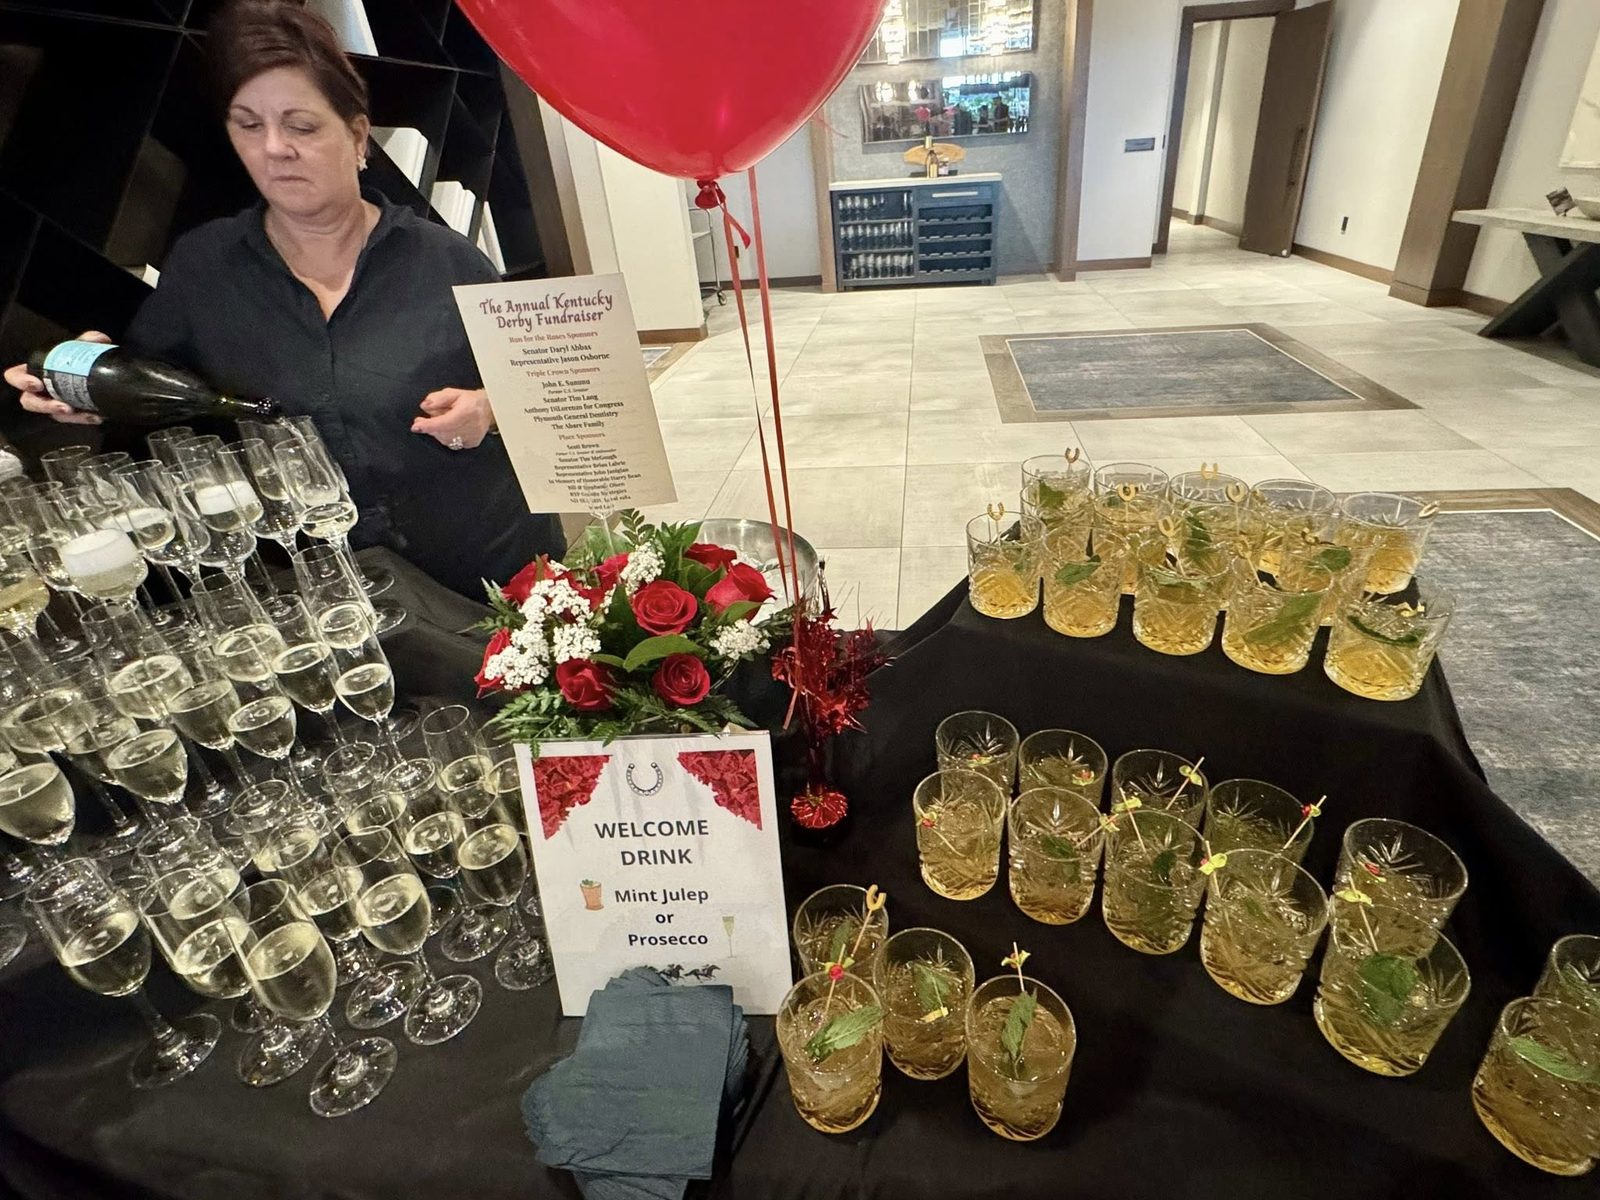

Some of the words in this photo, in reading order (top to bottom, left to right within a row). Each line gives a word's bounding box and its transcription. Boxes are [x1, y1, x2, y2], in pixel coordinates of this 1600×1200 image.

[480, 298, 502, 315] The
[505, 294, 550, 313] Annual
[553, 289, 613, 311] Kentucky
[496, 313, 532, 332] Derby
[536, 310, 604, 326] Fundraiser
[547, 333, 565, 341] Roses
[566, 331, 599, 340] Sponsors
[522, 347, 549, 355] Senator
[550, 345, 569, 354] Daryl
[571, 343, 592, 352] Abbas
[510, 356, 559, 367] Representative
[560, 355, 580, 364] Jason
[580, 353, 610, 362] Osborne
[526, 370, 546, 378] Triple
[547, 368, 569, 376] Crown
[570, 367, 600, 375] Sponsors
[542, 381, 557, 389] John
[582, 394, 599, 402] Lang
[524, 406, 549, 414] Anthony
[583, 402, 593, 410] for
[594, 401, 624, 410] Congress
[533, 414, 563, 423] Plymouth
[564, 412, 588, 420] General
[589, 410, 619, 419] Dentistry
[583, 420, 605, 428] Family
[576, 432, 606, 440] Sponsors
[594, 820, 710, 839] WELCOME
[620, 848, 694, 866] DRINK
[614, 889, 658, 903] Mint
[661, 887, 709, 905] Julep
[655, 913, 675, 924] or
[628, 934, 709, 946] Prosecco
